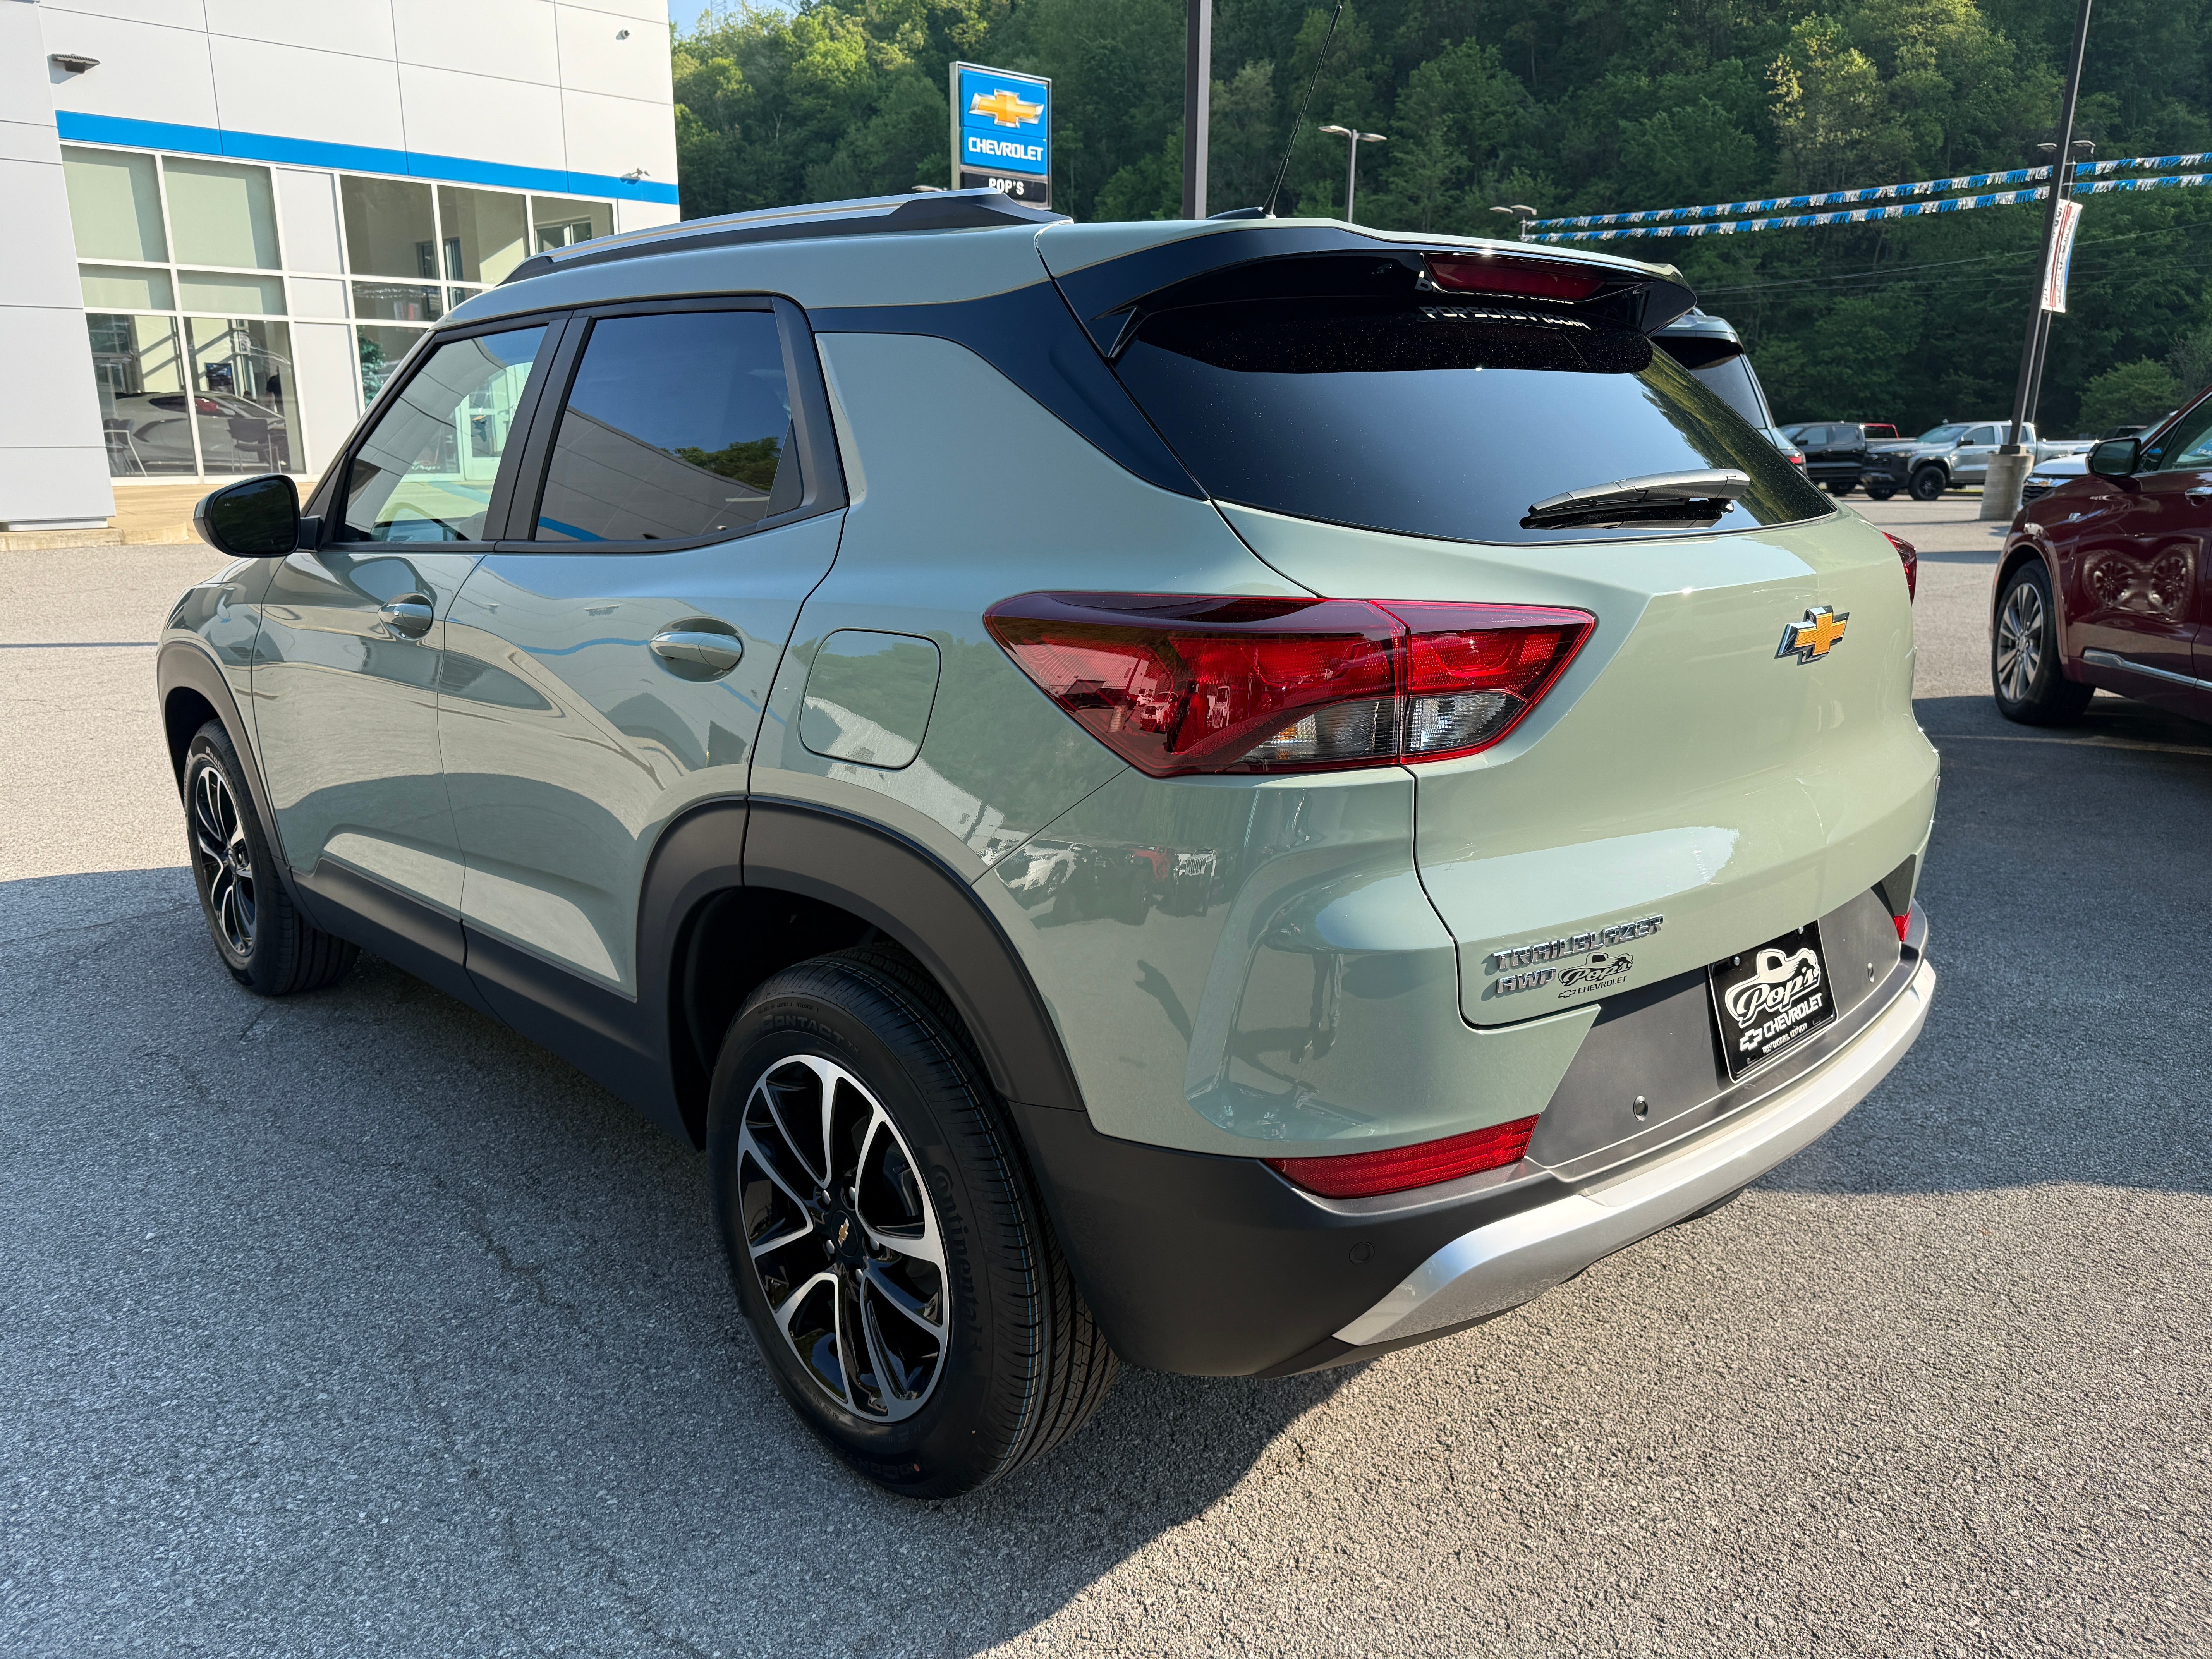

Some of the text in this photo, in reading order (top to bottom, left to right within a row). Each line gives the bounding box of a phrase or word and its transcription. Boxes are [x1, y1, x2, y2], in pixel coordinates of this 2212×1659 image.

[968, 137, 1044, 161] CHEVROLET
[989, 177, 1024, 195] POP'S
[1493, 914, 1664, 969] TRAILBLAZER
[1496, 966, 1557, 994] AWD
[1578, 975, 1627, 994] CHEVROLET
[1736, 967, 1821, 1020] Pop's
[1764, 993, 1822, 1038] CHEVROLET
